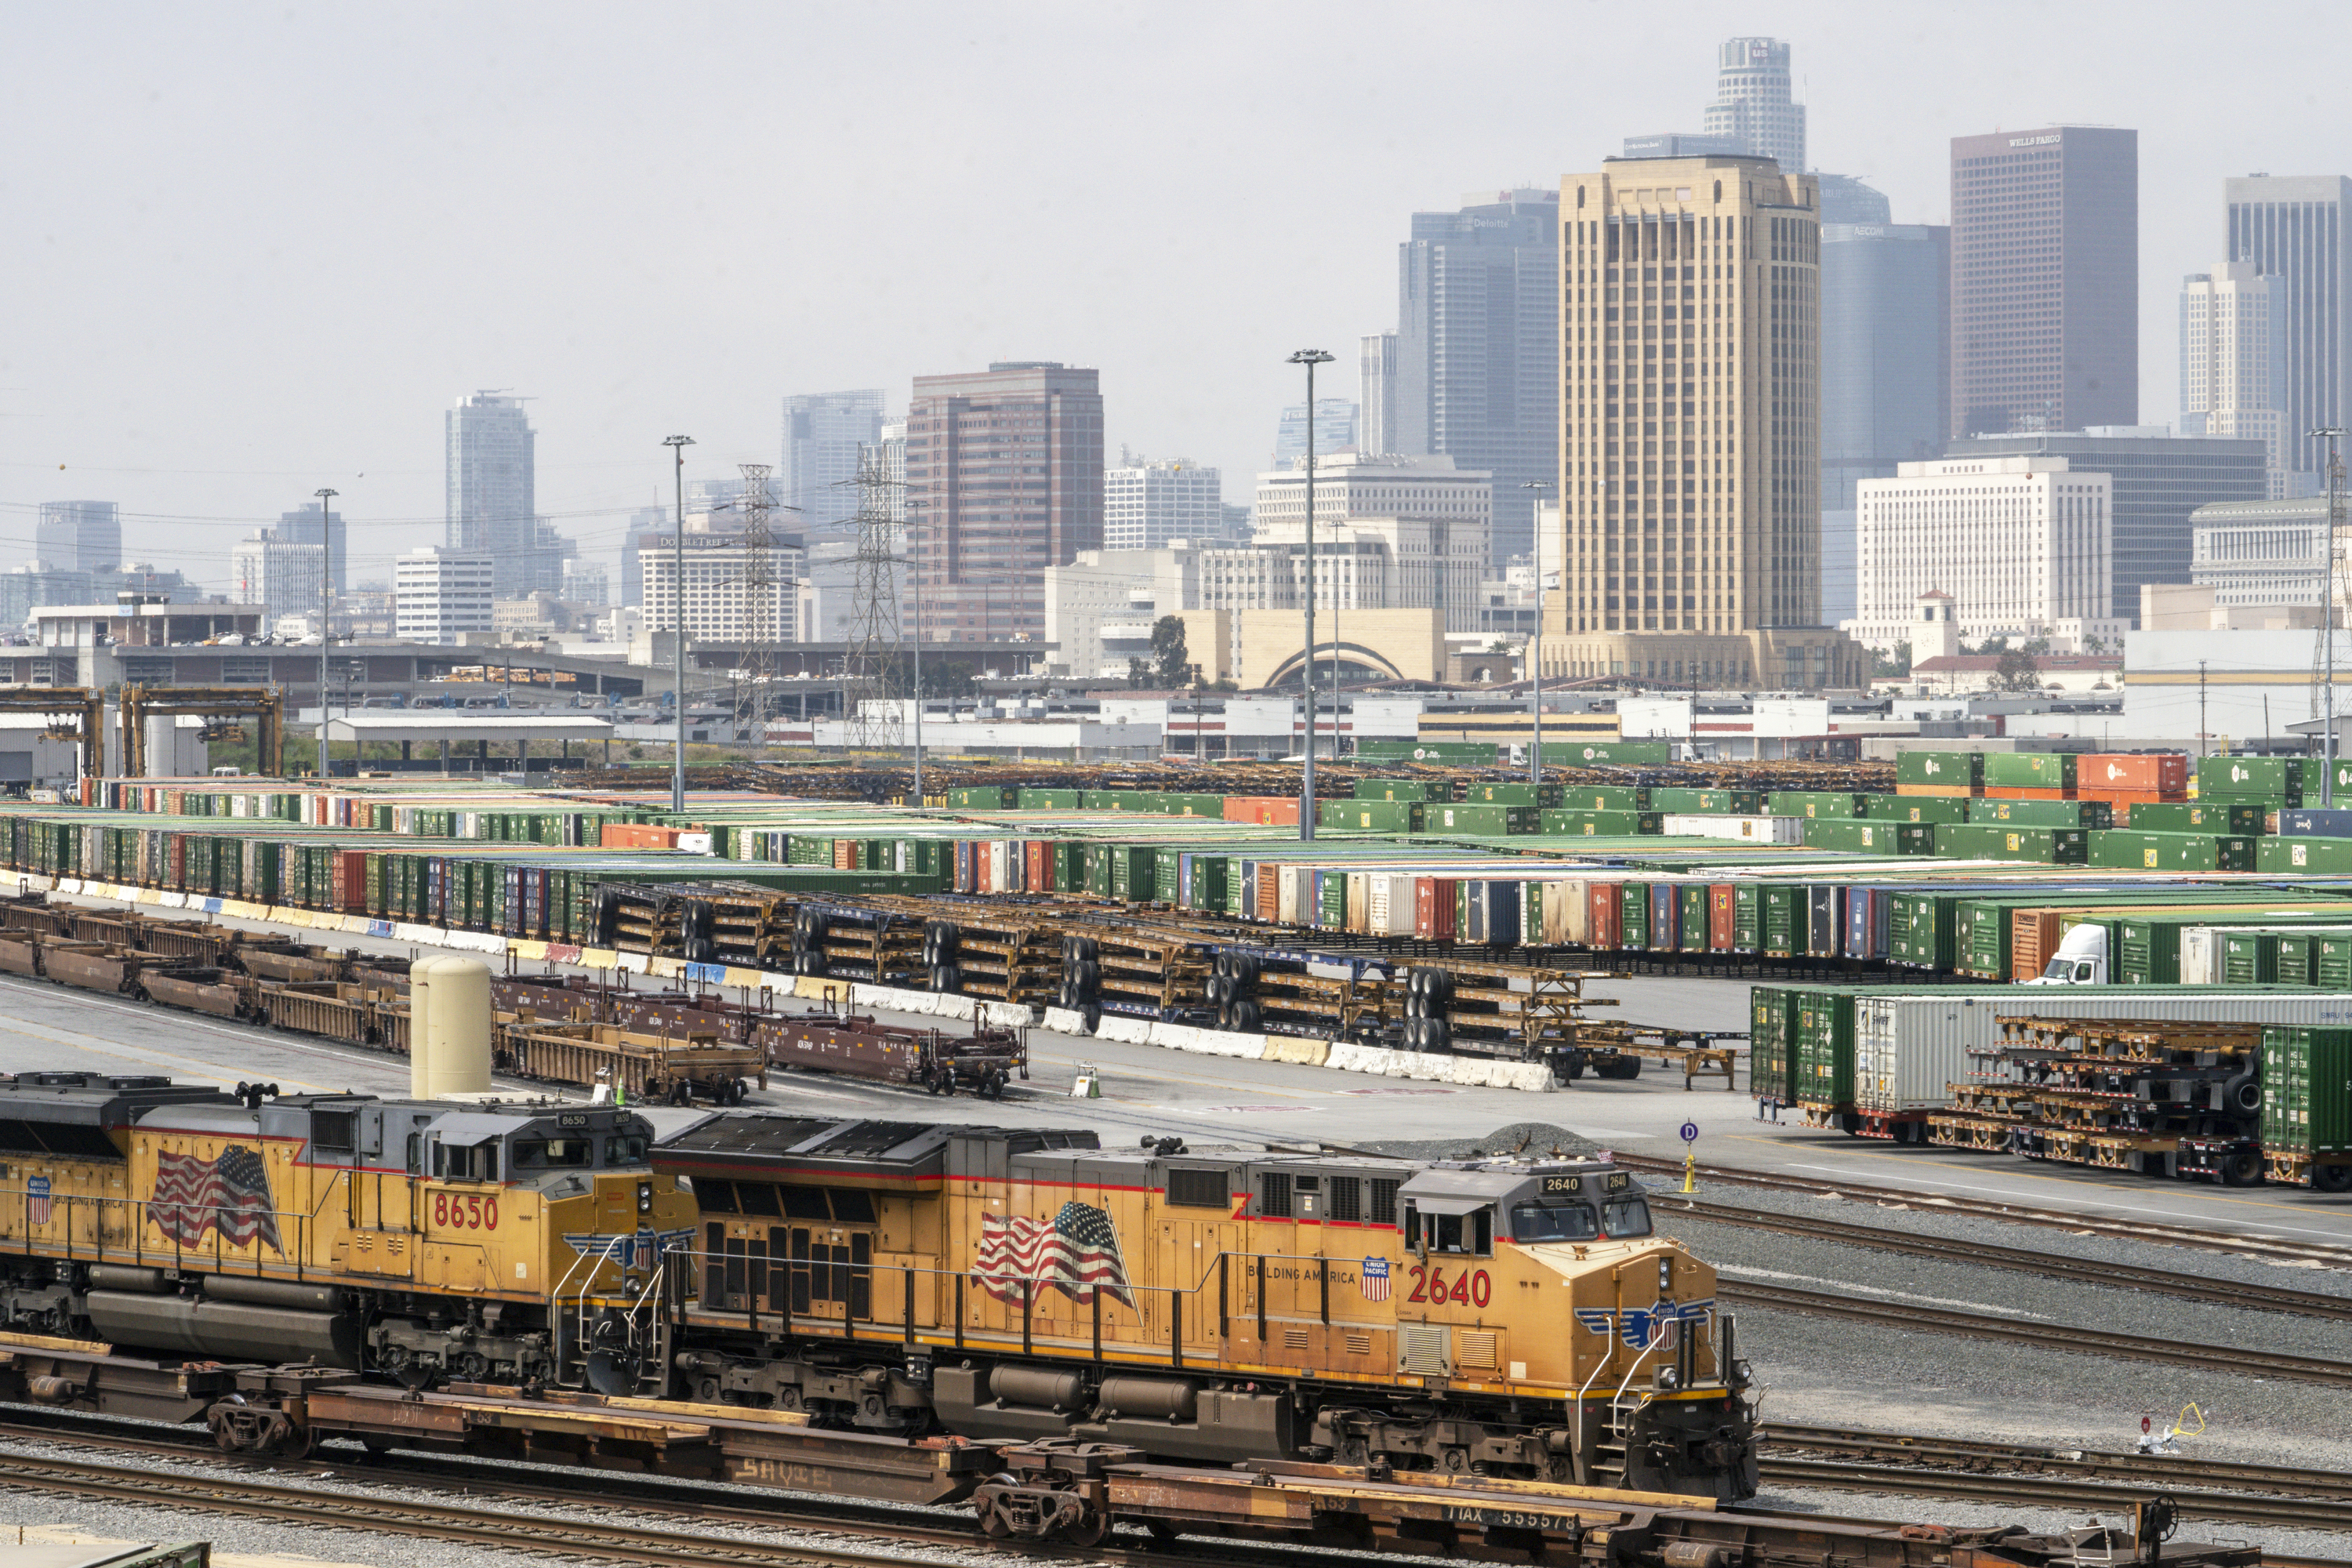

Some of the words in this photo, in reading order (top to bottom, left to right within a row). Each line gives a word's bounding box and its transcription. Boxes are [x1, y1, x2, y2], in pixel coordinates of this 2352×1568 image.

[2009, 137, 2035, 147] WELLS
[2036, 135, 2061, 145] FARGO
[1474, 219, 1508, 228] Deloitte
[1854, 227, 1883, 235] AECOM
[660, 537, 722, 546] DOBLETREE
[562, 1115, 586, 1125] 8650
[615, 1113, 630, 1123] 8650
[1686, 1125, 1695, 1139] D
[1597, 1150, 1612, 1159] STOP
[1548, 1178, 1578, 1191] 2640
[1610, 1174, 1626, 1188] 2640
[435, 1193, 498, 1231] 8650
[1365, 1267, 1387, 1276] PACIFIC
[1407, 1265, 1491, 1308] 2640
[477, 1412, 492, 1424] 53
[621, 1425, 651, 1441] TTX
[1502, 1509, 1575, 1530] 555578
